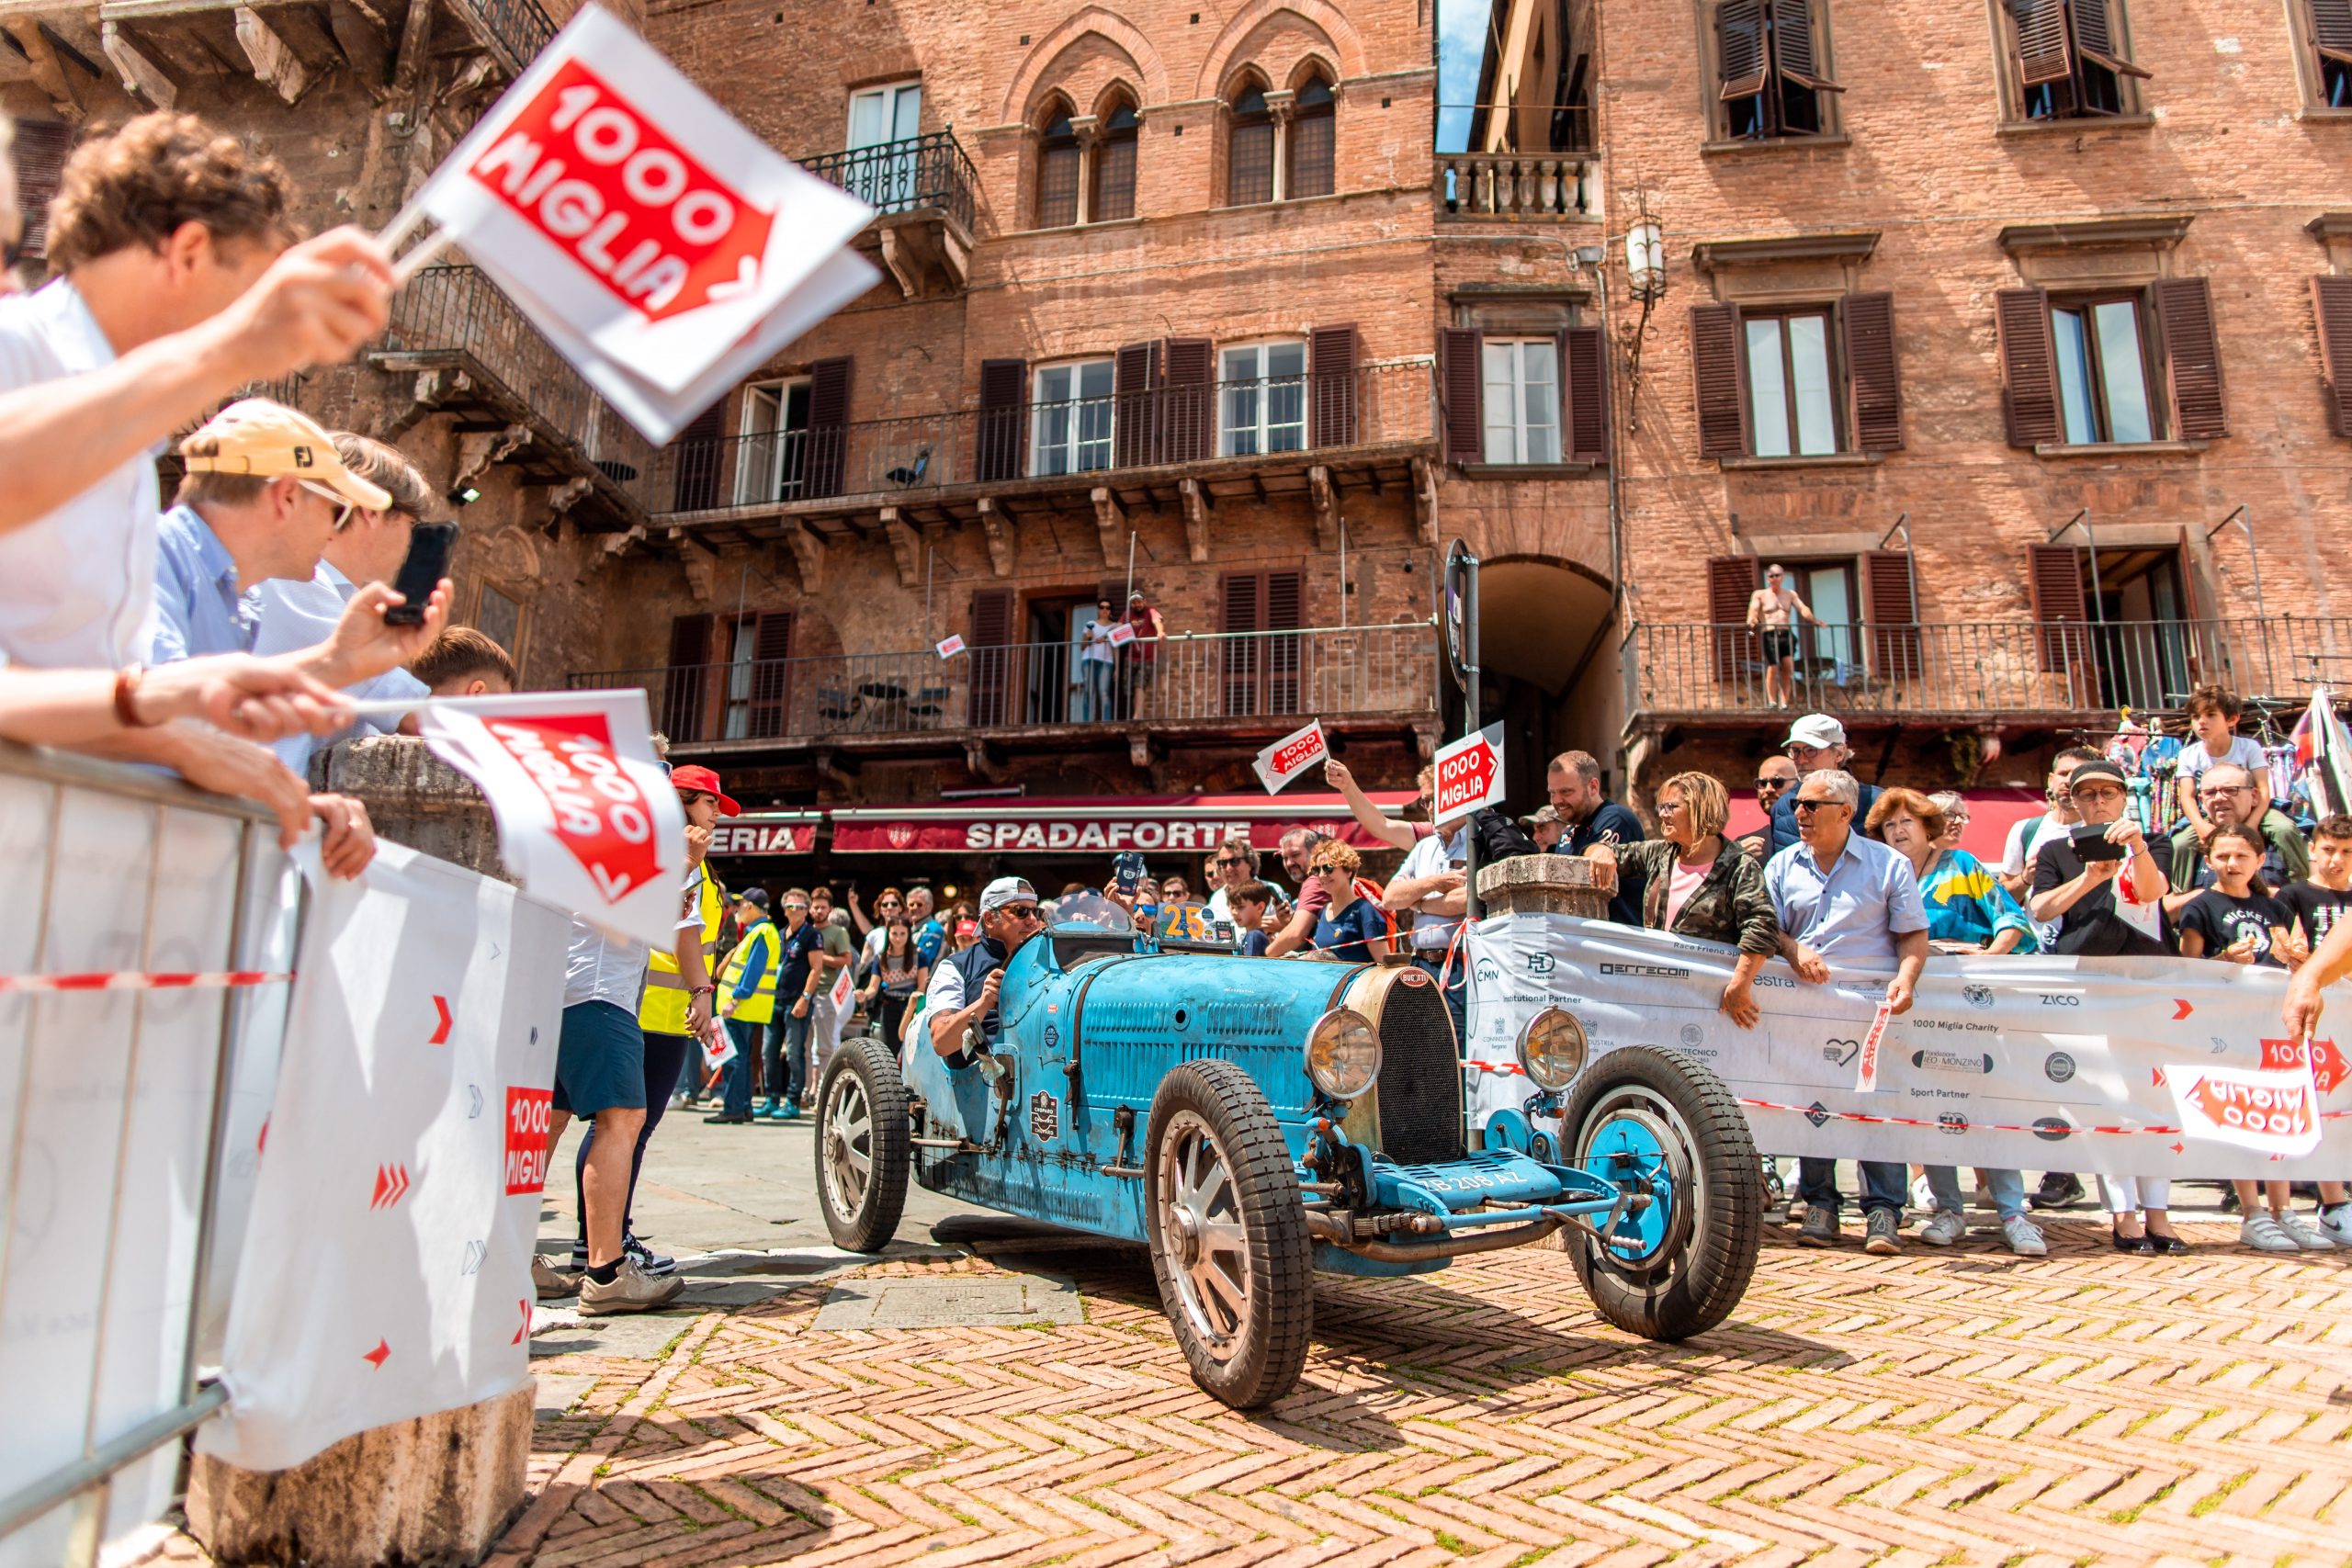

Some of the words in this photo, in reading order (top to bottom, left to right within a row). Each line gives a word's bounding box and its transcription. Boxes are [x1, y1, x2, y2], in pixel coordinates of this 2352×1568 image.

[549, 85, 734, 247] 1000
[478, 132, 690, 311] MIGLIA
[1282, 735, 1316, 759] 1000
[1284, 743, 1322, 771] MIGLIA
[491, 723, 603, 837] MIGLIA
[1442, 750, 1479, 782] 1000
[559, 732, 650, 844] 1000
[1440, 775, 1484, 809] MIGLIA
[966, 821, 1251, 849] SPADAFORTE
[1164, 905, 1204, 937] 25
[2223, 908, 2271, 926] MICKEY
[1674, 942, 1695, 950] Race
[1503, 994, 1546, 1003] Institutional
[1548, 995, 1582, 1004] Partner
[2040, 994, 2079, 1007] ZICO
[1913, 1020, 1935, 1029] 1000
[1938, 1021, 1963, 1032] Miglia
[1965, 1022, 1999, 1032] Charity
[1911, 1088, 1934, 1099] Sport
[1936, 1089, 1970, 1100] Partner
[2210, 1081, 2304, 1111] MIGLIA
[2223, 1106, 2305, 1135] 1000
[1449, 1176, 1495, 1190] 208
[1494, 1171, 1528, 1185] AZ
